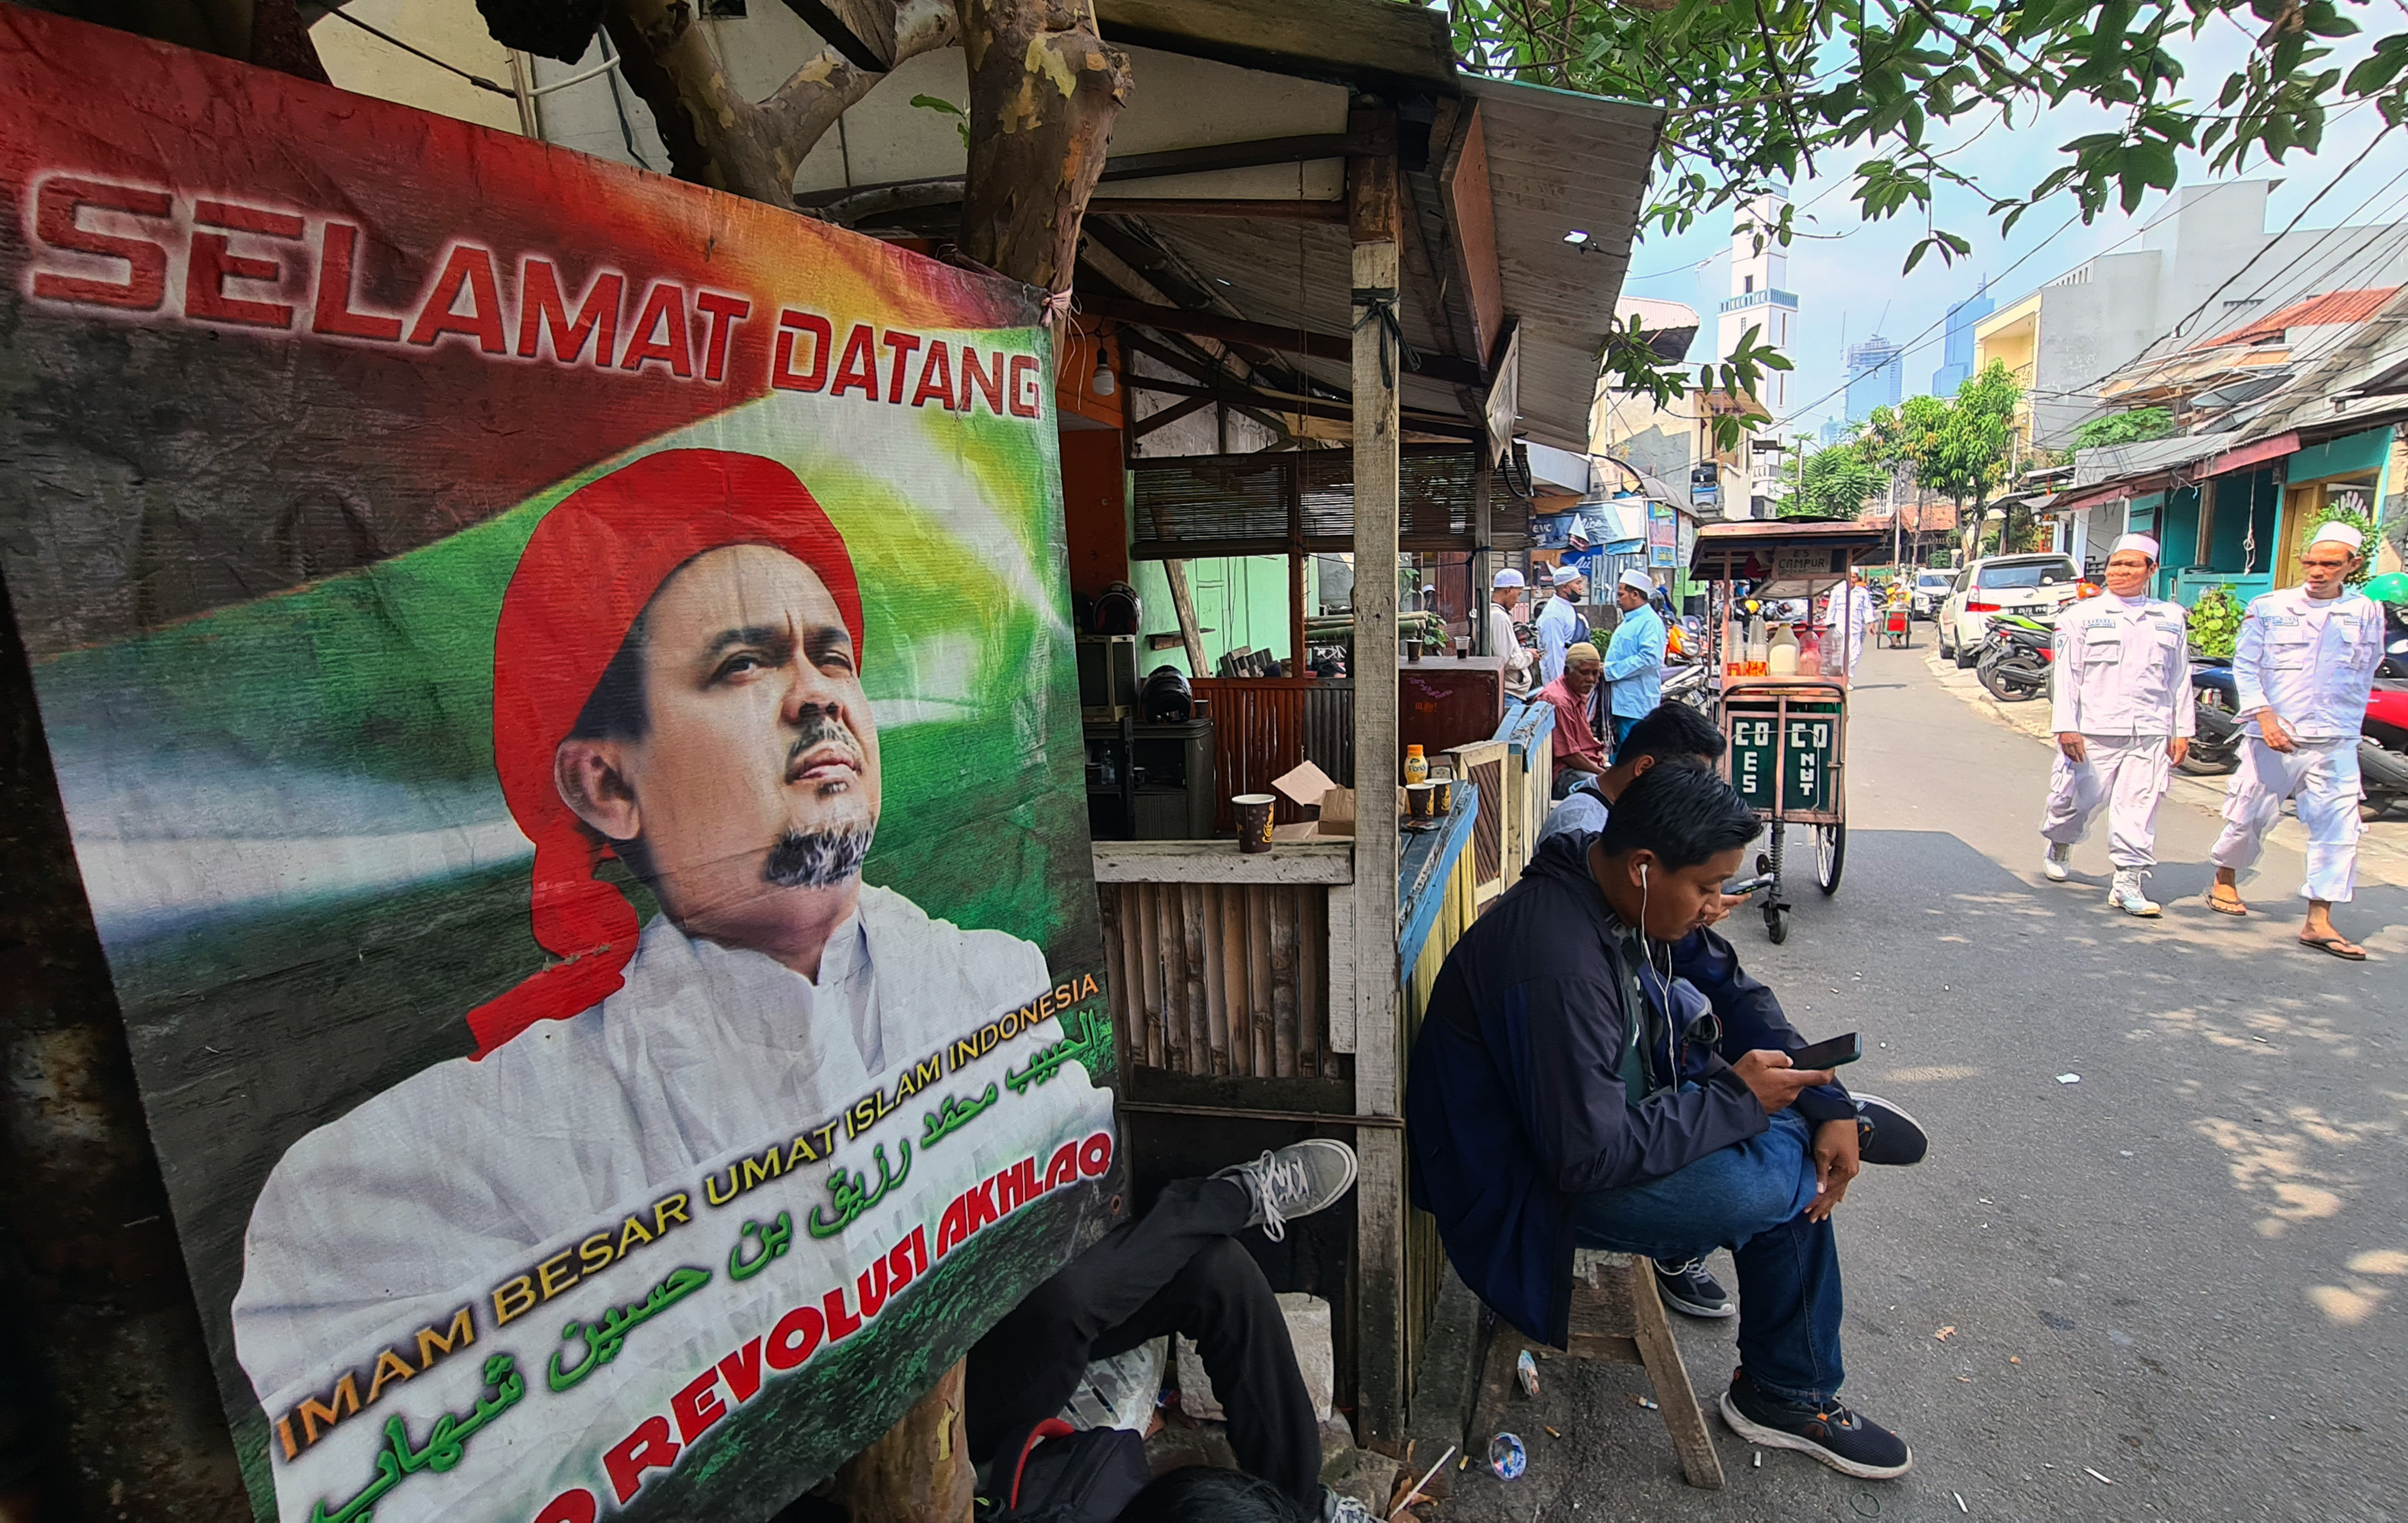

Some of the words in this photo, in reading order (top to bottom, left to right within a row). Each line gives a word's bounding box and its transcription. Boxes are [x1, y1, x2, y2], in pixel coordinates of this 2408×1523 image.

[32, 175, 750, 382] SELAMAT
[771, 309, 1041, 419] DATANG
[1779, 558, 1825, 569] CAMPUR
[1799, 753, 1815, 796] NUT
[1007, 1008, 1100, 1095] الحبيب
[275, 1307, 477, 1462] IMAM
[491, 1193, 690, 1326] BESAR
[704, 1121, 839, 1206] UMAT
[844, 1052, 941, 1139] ISLAM
[949, 973, 1100, 1073] INDONESIA
[808, 1135, 912, 1239] رزيق
[729, 1210, 793, 1280] بن
[548, 1268, 713, 1392] حسين
[603, 1223, 928, 1504] REVOLUSI
[937, 1131, 1113, 1261] AKHLAQ
